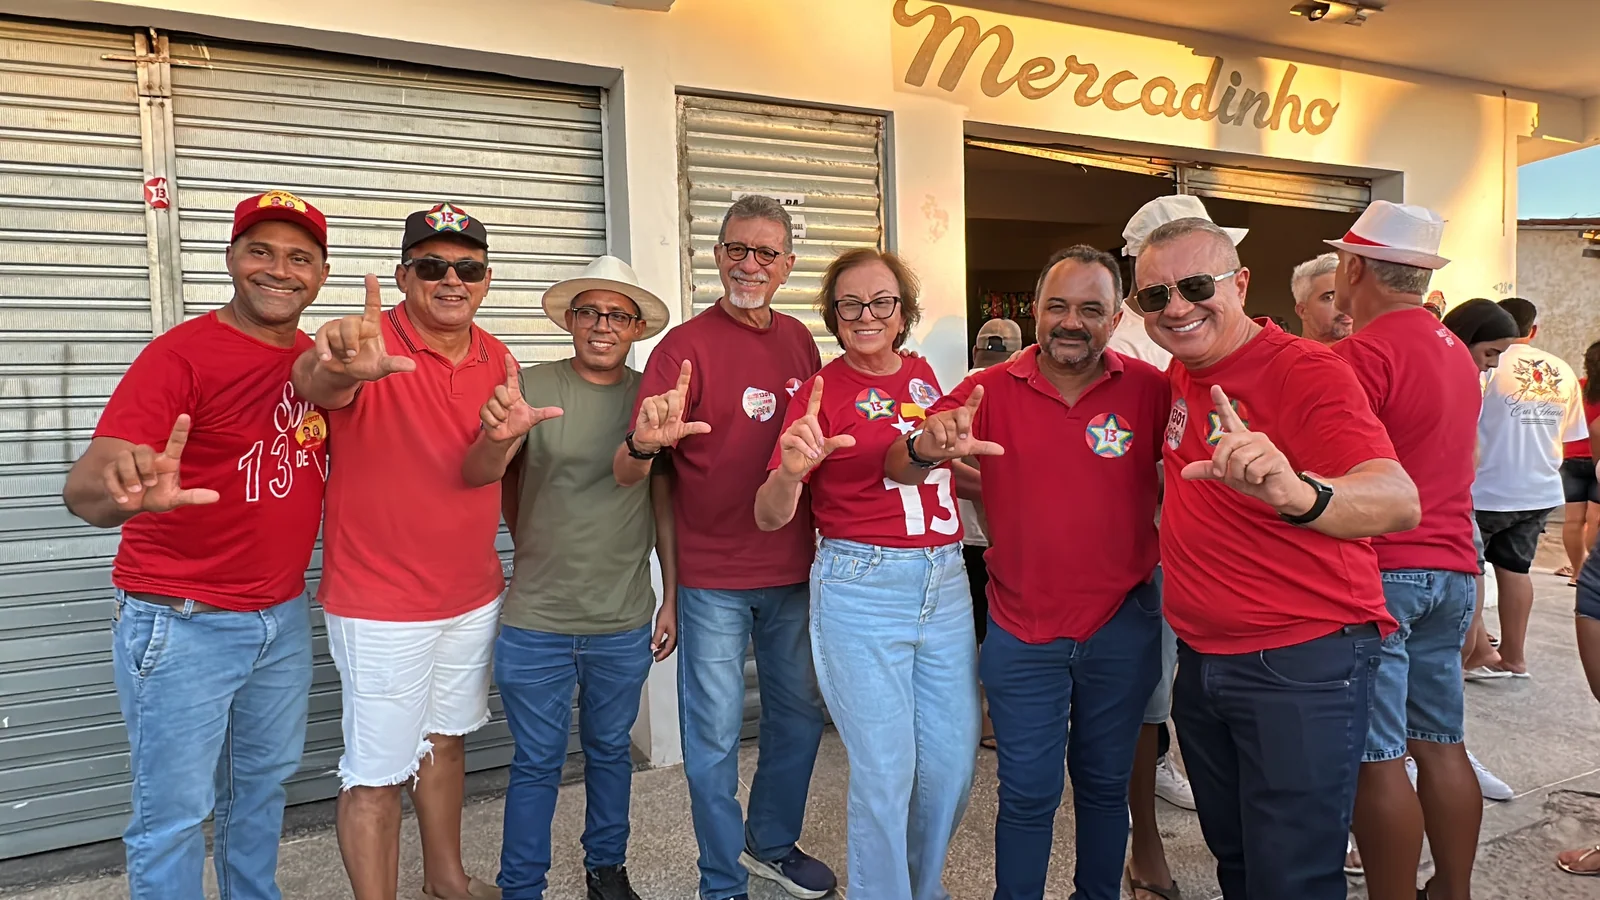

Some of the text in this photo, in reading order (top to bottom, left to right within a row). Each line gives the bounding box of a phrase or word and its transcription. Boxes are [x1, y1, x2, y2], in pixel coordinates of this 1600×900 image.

[893, 0, 1340, 135] Mercadinho
[154, 188, 166, 198] 13
[441, 212, 455, 223] 13
[869, 401, 884, 412] 13
[1104, 428, 1118, 442] 13
[238, 433, 293, 502] 13
[296, 449, 310, 468] DE
[883, 472, 959, 536] 13
